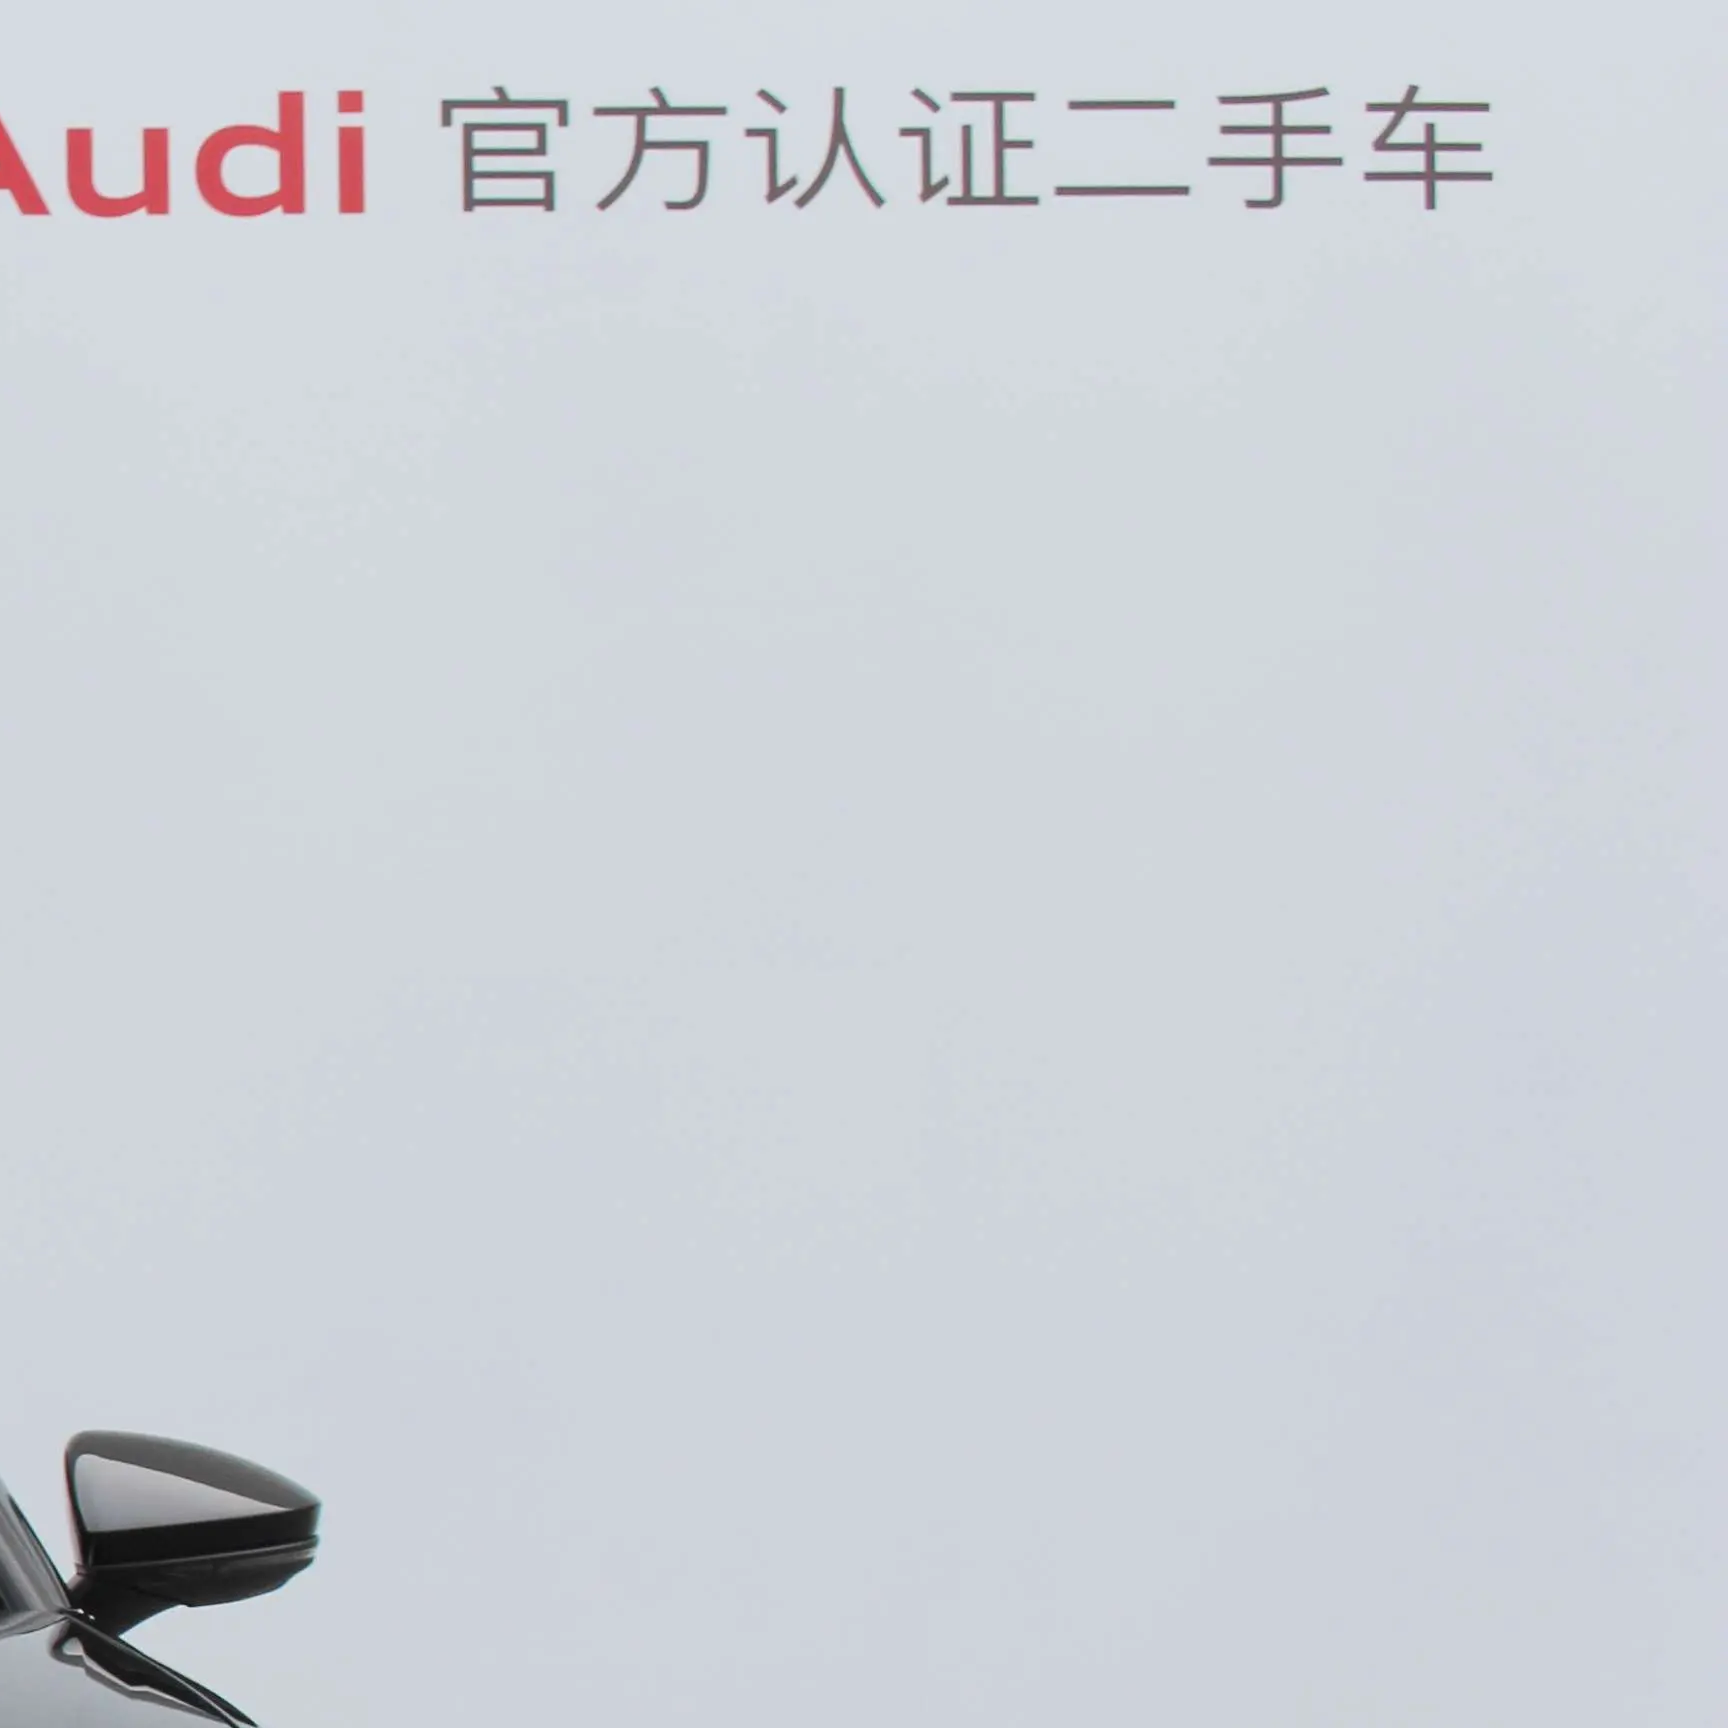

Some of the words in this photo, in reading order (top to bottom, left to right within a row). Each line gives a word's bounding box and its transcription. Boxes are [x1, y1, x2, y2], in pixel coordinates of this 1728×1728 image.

[439, 84, 1497, 213] 官方认证二手车
